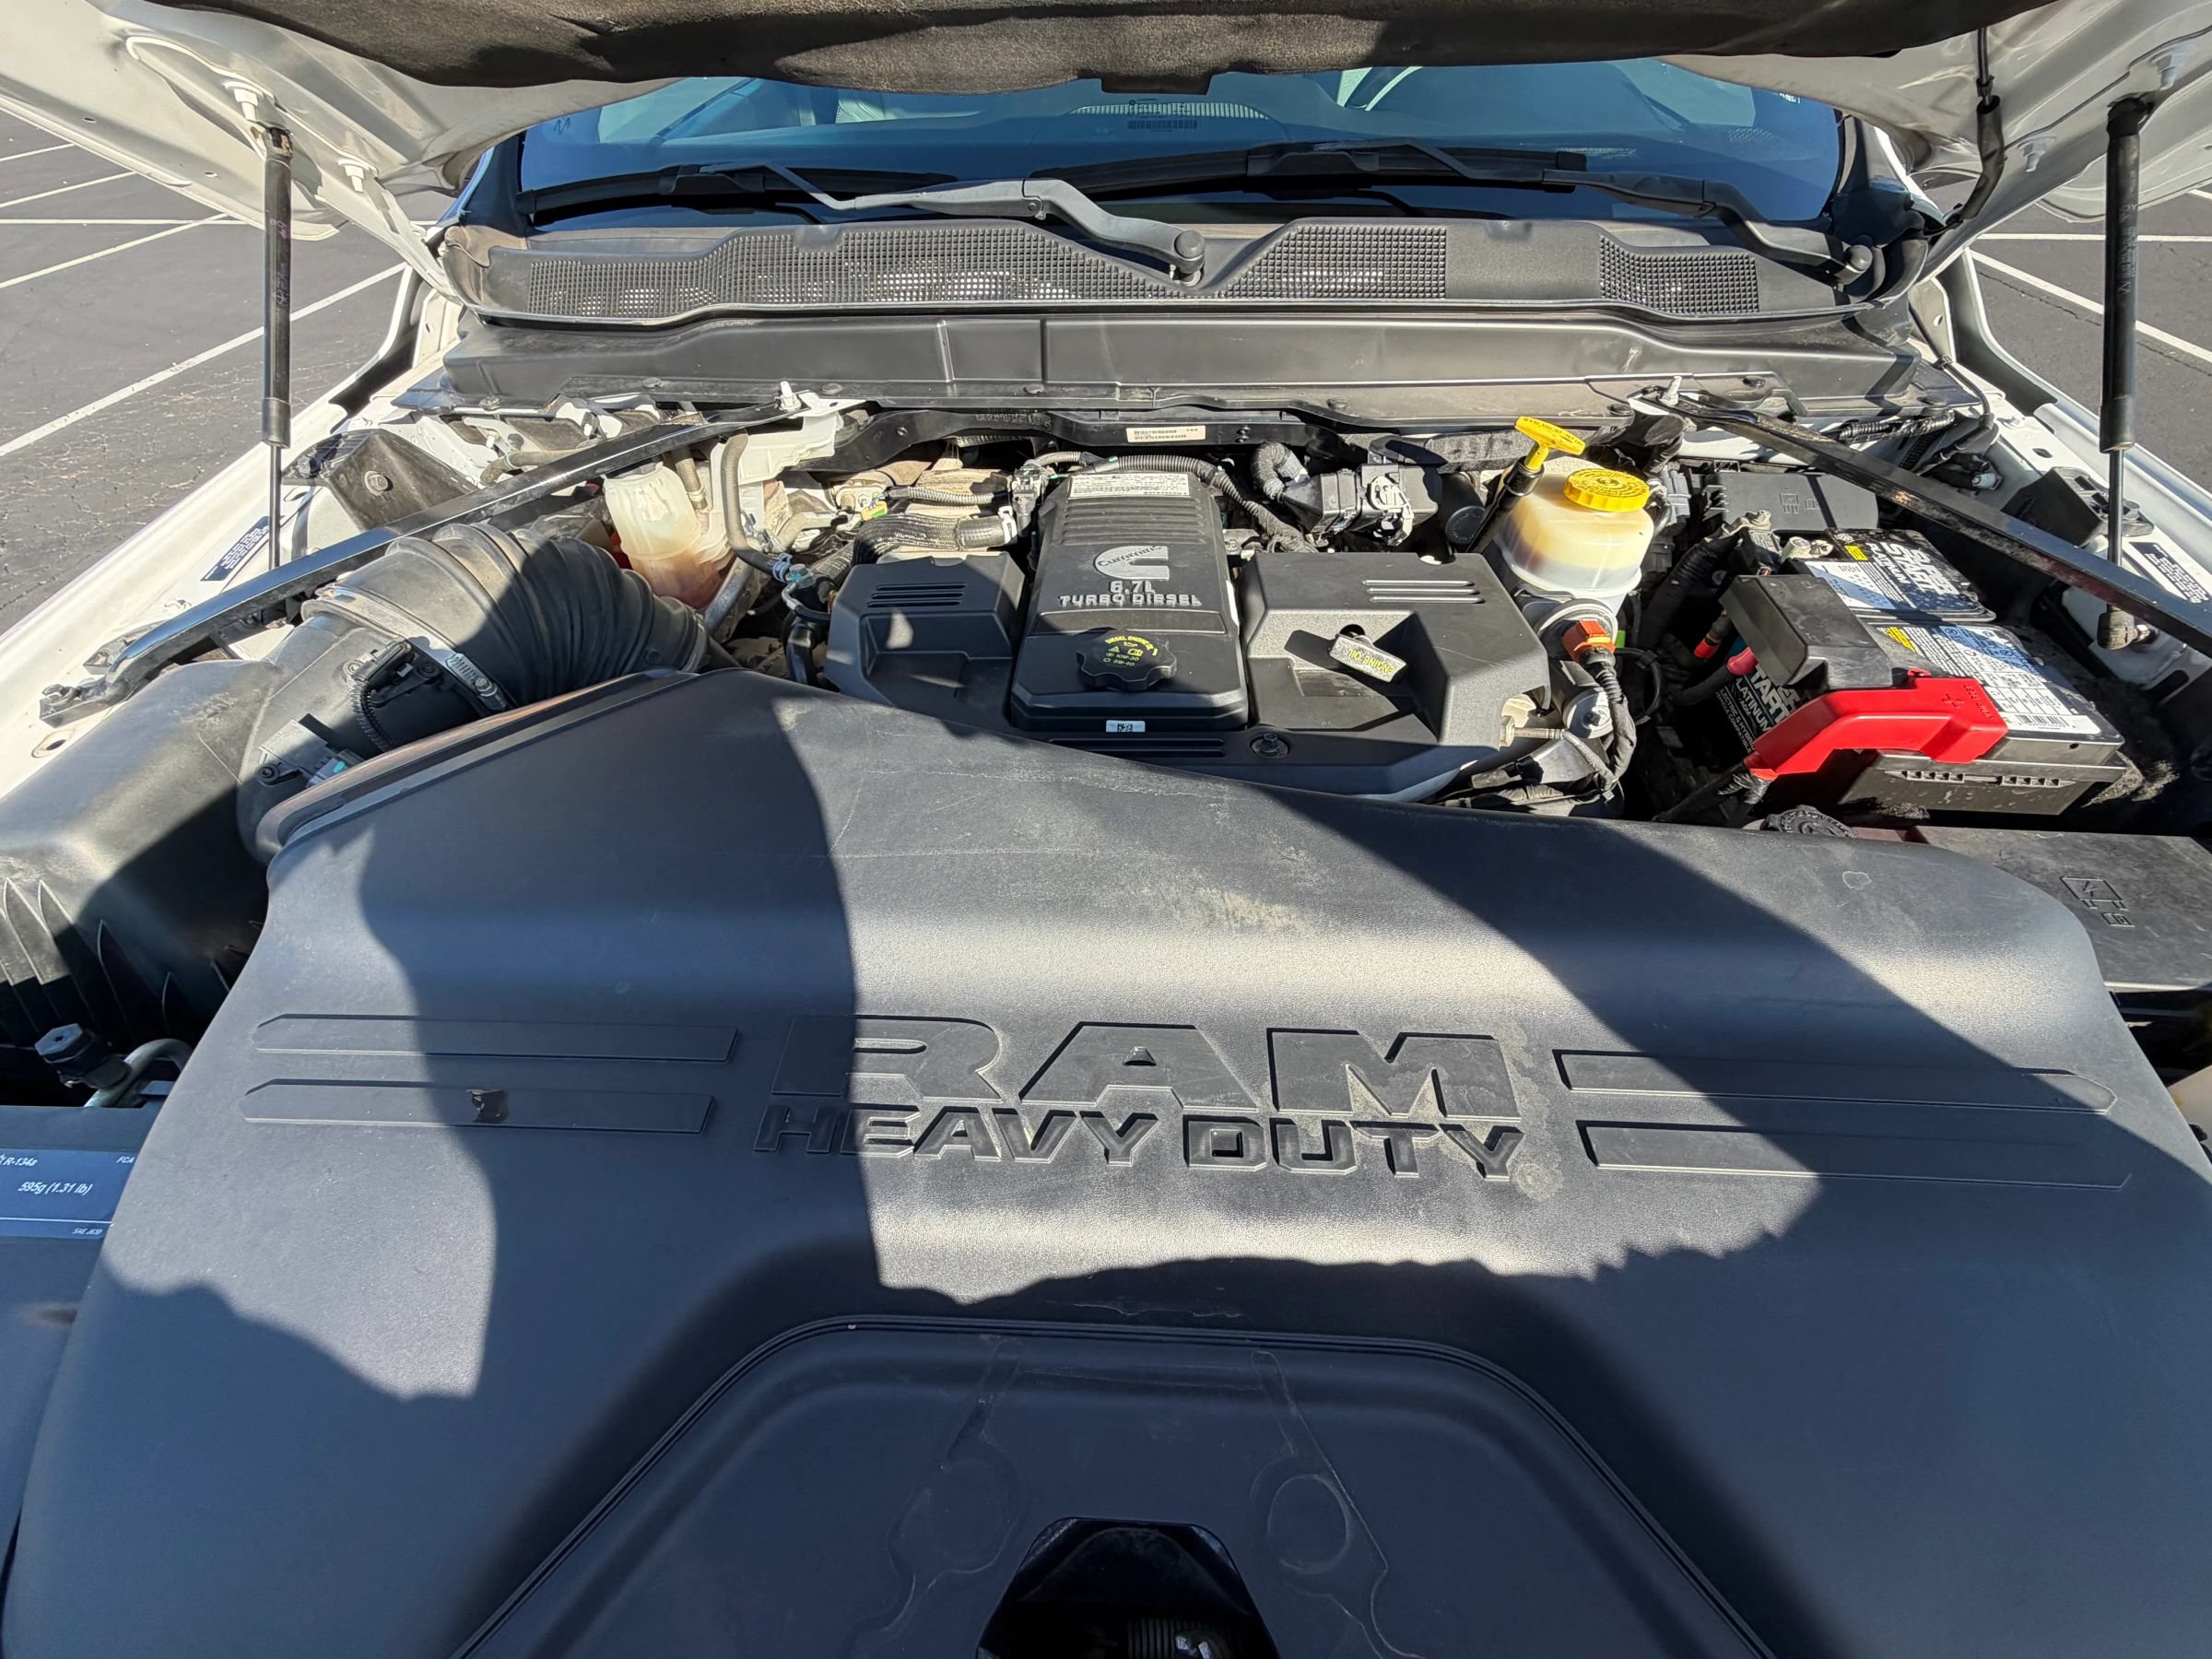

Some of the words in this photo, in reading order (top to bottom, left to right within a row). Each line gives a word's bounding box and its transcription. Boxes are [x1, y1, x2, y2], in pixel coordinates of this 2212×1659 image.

[1098, 546, 1162, 566] Cummins
[1865, 543, 1911, 583] PLATINUM
[1880, 542, 1934, 592] START
[1908, 549, 1960, 594] SUPER
[1059, 594, 1125, 607] TURBO
[1132, 594, 1202, 606] DIESEL
[1111, 581, 1155, 594] 6.7L
[1347, 648, 1362, 660] OIL
[1363, 656, 1394, 674] ENGINE
[1750, 664, 1790, 724] TART
[771, 1015, 1522, 1122] RAM
[755, 1103, 1158, 1166] HEAVY
[1183, 1114, 1525, 1182] DUTY
[18, 1182, 48, 1194] 595g
[44, 1182, 77, 1194] (1.31
[74, 1183, 94, 1196] lb)
